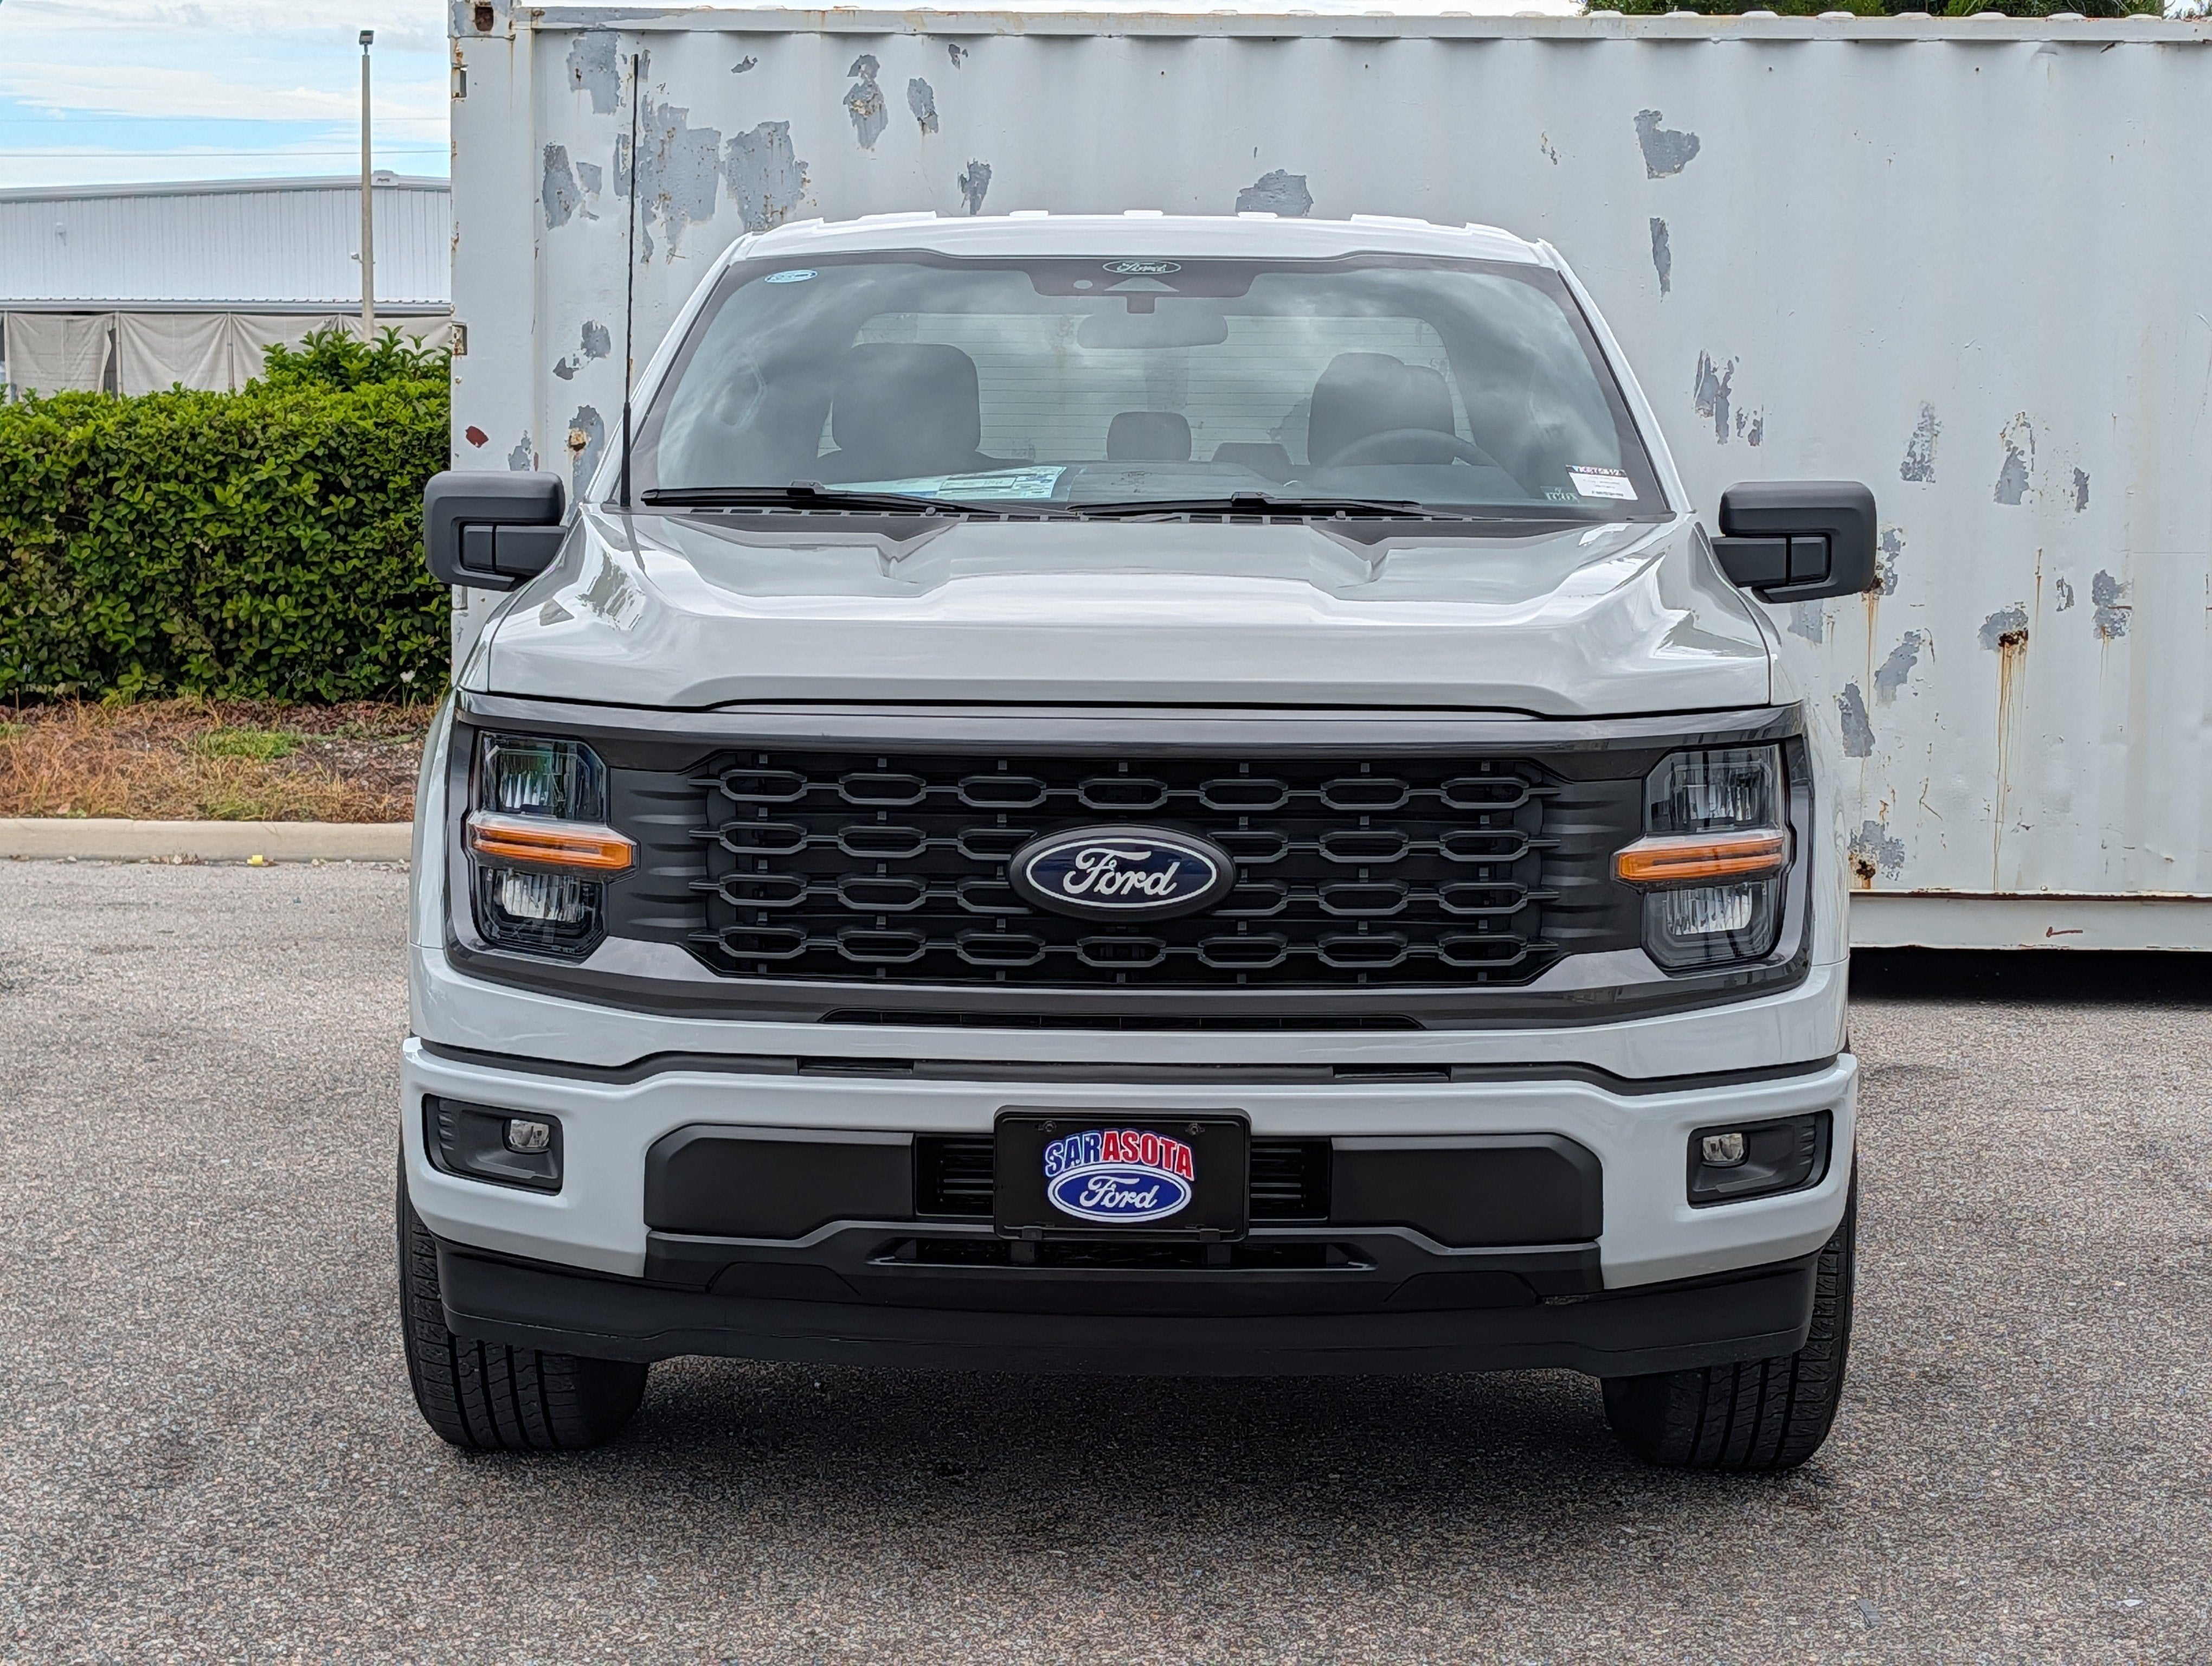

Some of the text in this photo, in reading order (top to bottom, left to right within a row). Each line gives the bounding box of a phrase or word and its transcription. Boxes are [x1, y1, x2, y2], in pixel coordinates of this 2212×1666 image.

[1116, 261, 1167, 273] Ford
[1063, 847, 1181, 895] Ford
[1044, 1130, 1195, 1182] SARASOTA
[1079, 1175, 1160, 1209] Ford
